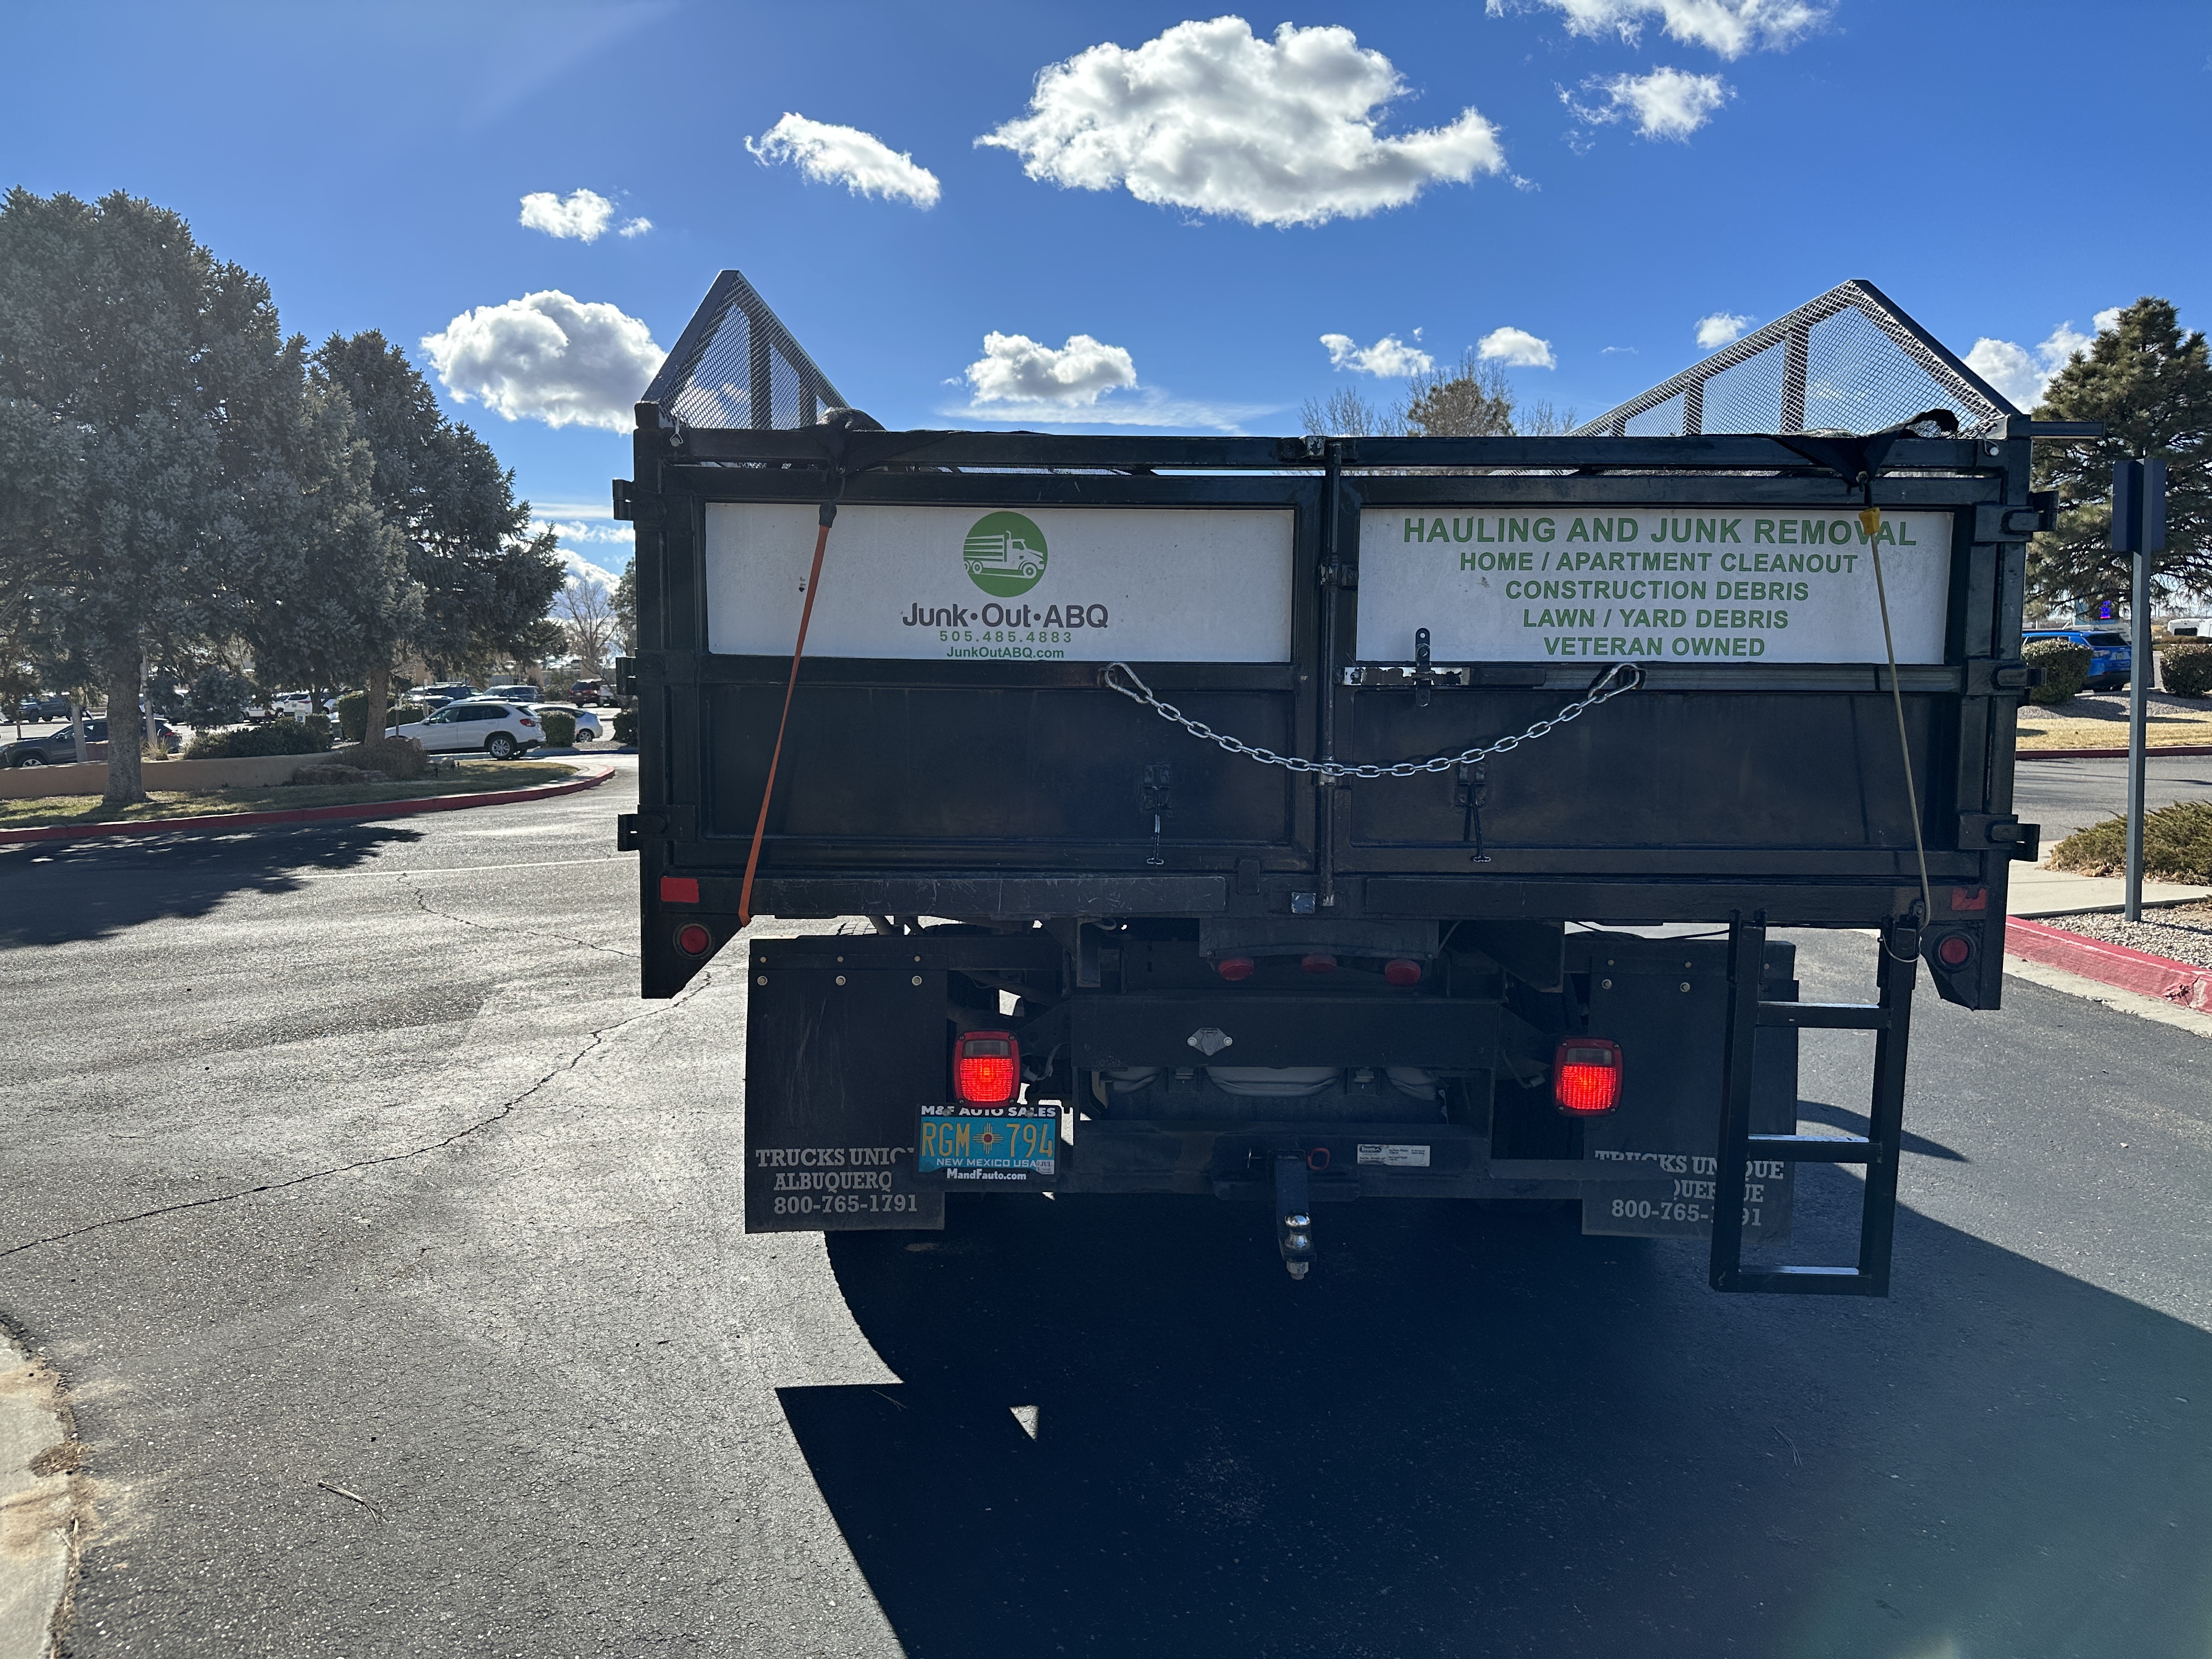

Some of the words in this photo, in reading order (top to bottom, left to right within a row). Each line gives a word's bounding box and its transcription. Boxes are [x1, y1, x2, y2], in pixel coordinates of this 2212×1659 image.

[1404, 518, 1555, 543] HAULING
[1566, 517, 1638, 542] AND
[1651, 518, 1742, 543] JUNK
[1754, 519, 1917, 546] REMOVAL
[1460, 552, 1533, 571] HOME
[1541, 552, 1549, 571] /
[1556, 552, 1712, 571] APARTMENT
[1720, 553, 1858, 573] CLEANOUT
[1505, 580, 1706, 600] CONSTRUCTION
[1716, 582, 1808, 601] DEBRIS
[1523, 609, 1595, 627] LAWN
[1603, 609, 1612, 627] /
[1620, 609, 1686, 628] YARD
[1696, 610, 1788, 629] DEBRIS
[939, 630, 1072, 643] 505.485.4883
[1544, 637, 1662, 655] VETERAN
[1672, 637, 1765, 656] OWNED
[946, 647, 1064, 659] JunkOutABQ.com
[959, 1107, 1004, 1116] AUTO
[1008, 1107, 1056, 1118] SALES
[921, 1122, 970, 1158] RGM
[1006, 1123, 1053, 1158] 794
[755, 1148, 845, 1167] TRUCKS
[849, 1147, 915, 1165] UNI
[936, 1158, 963, 1166] NEW
[967, 1159, 1011, 1167] MEXICO
[946, 1168, 1027, 1180] MandFauto.com
[1691, 1156, 1784, 1180] UNUE
[774, 1171, 892, 1193] ALBUQUERQ
[774, 1194, 918, 1214] 800-765-1791
[1611, 1199, 1762, 1226] 800-765-91
